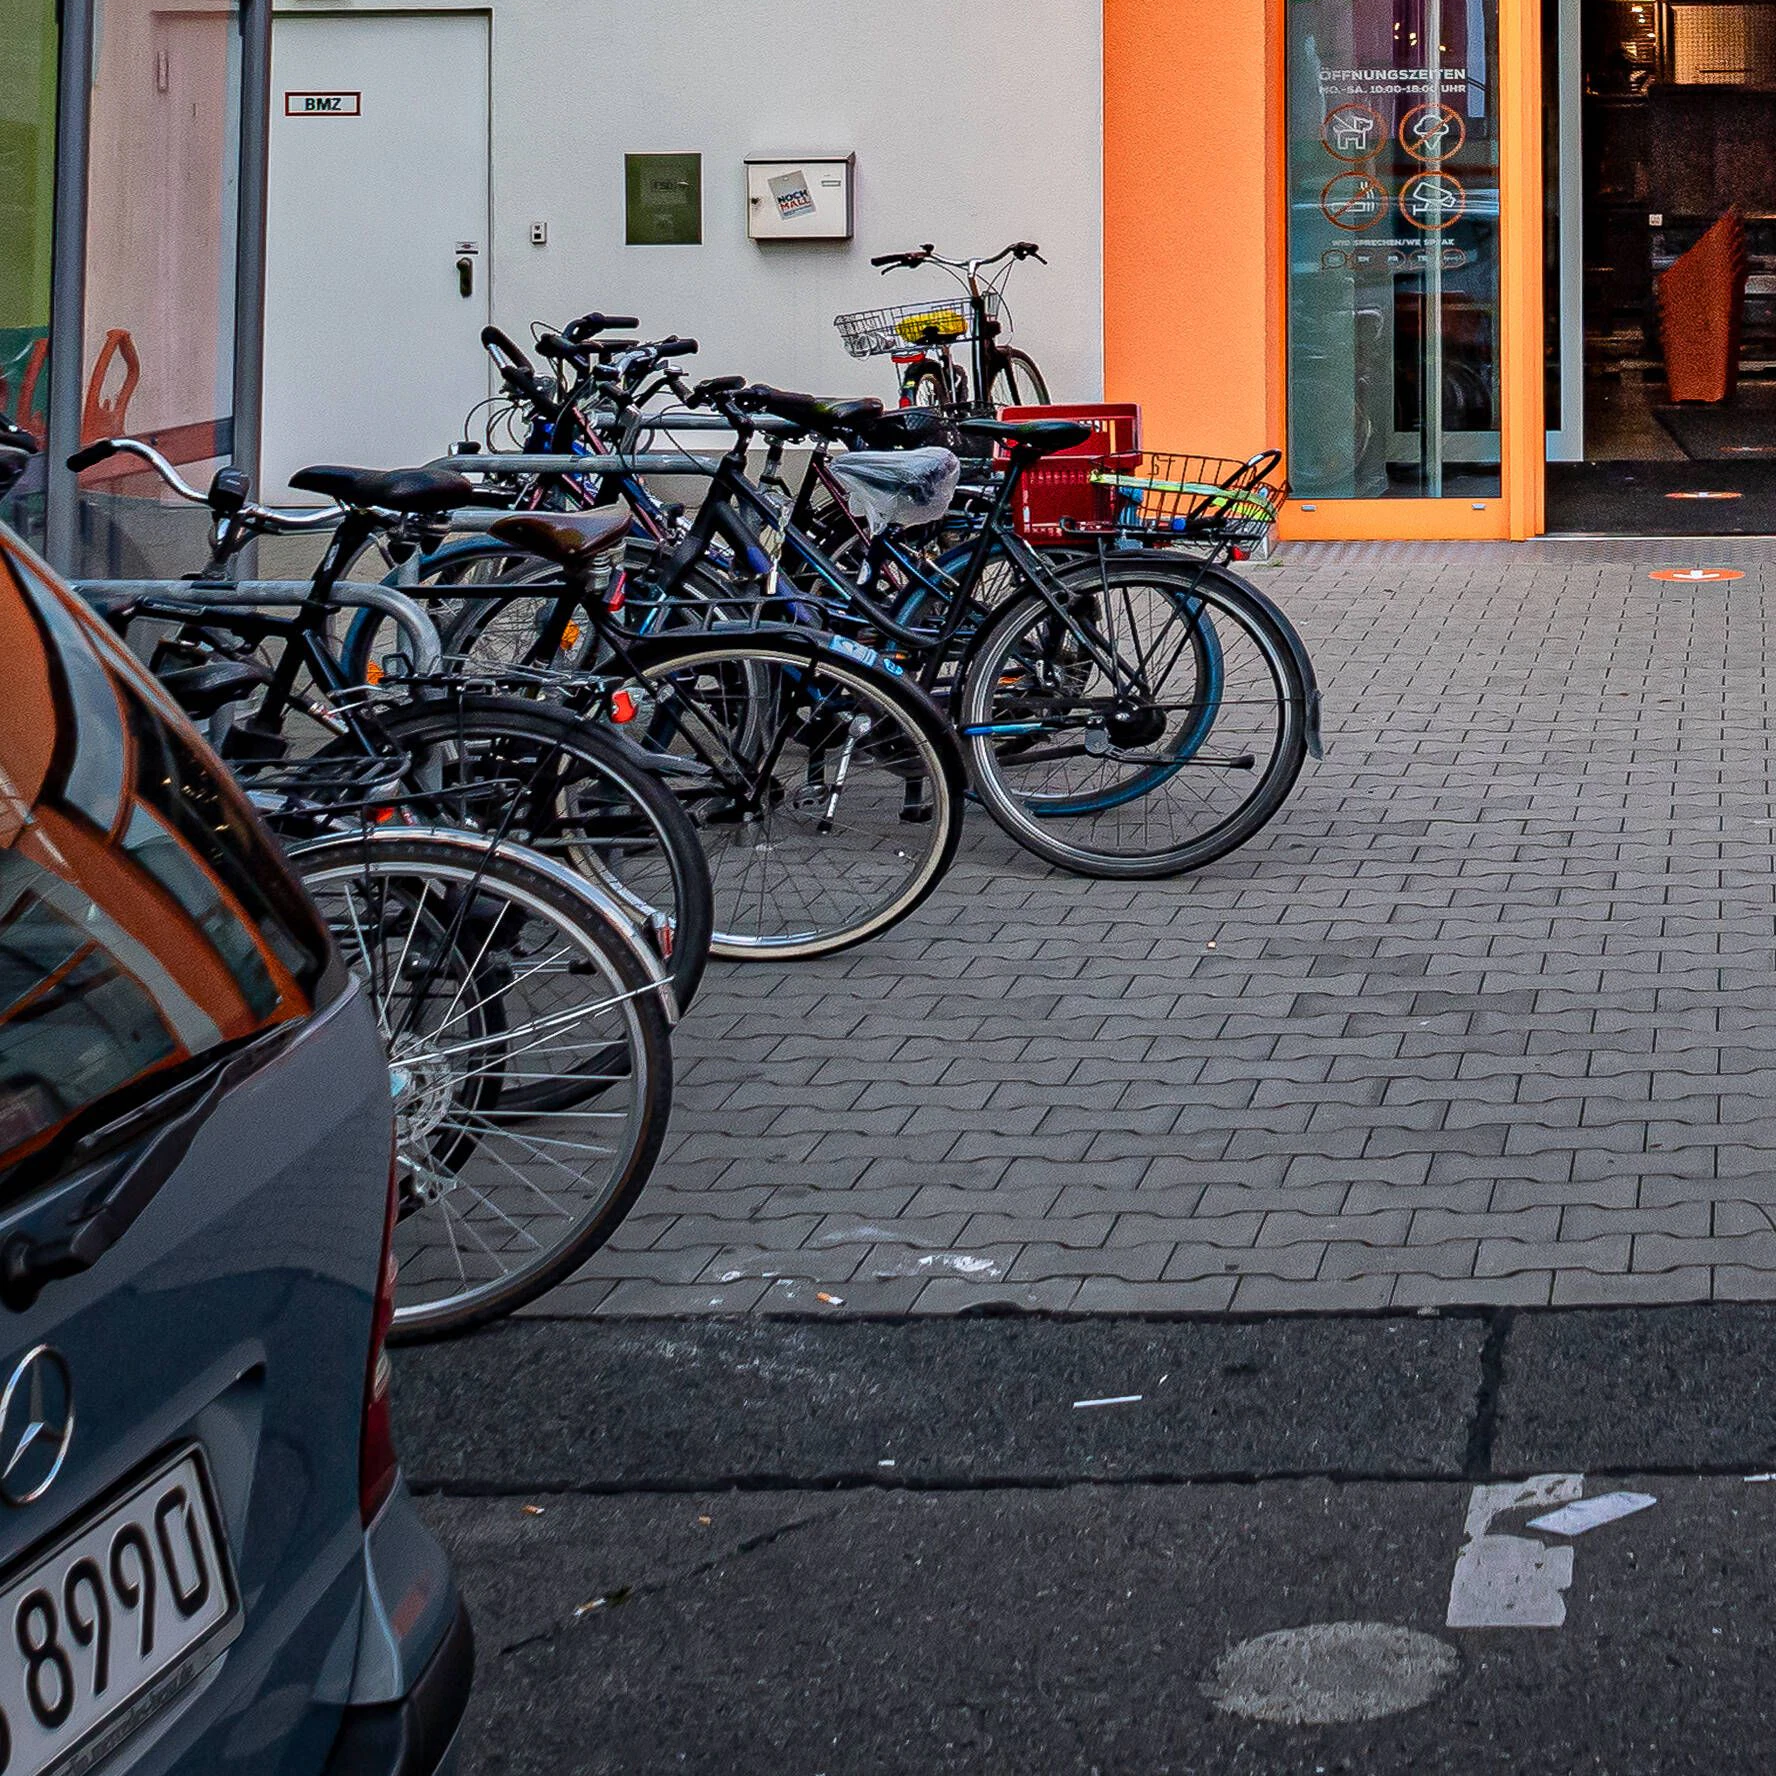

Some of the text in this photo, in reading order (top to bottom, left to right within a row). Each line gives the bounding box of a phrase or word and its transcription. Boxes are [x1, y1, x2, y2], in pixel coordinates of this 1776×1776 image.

[1319, 67, 1466, 81] ÖFFNUNGSZEITEN
[1440, 84, 1466, 93] UHR
[304, 97, 342, 111] BMZ
[777, 189, 808, 205] NOCH
[780, 198, 812, 211] MALL
[14, 1484, 211, 1730] 8990
